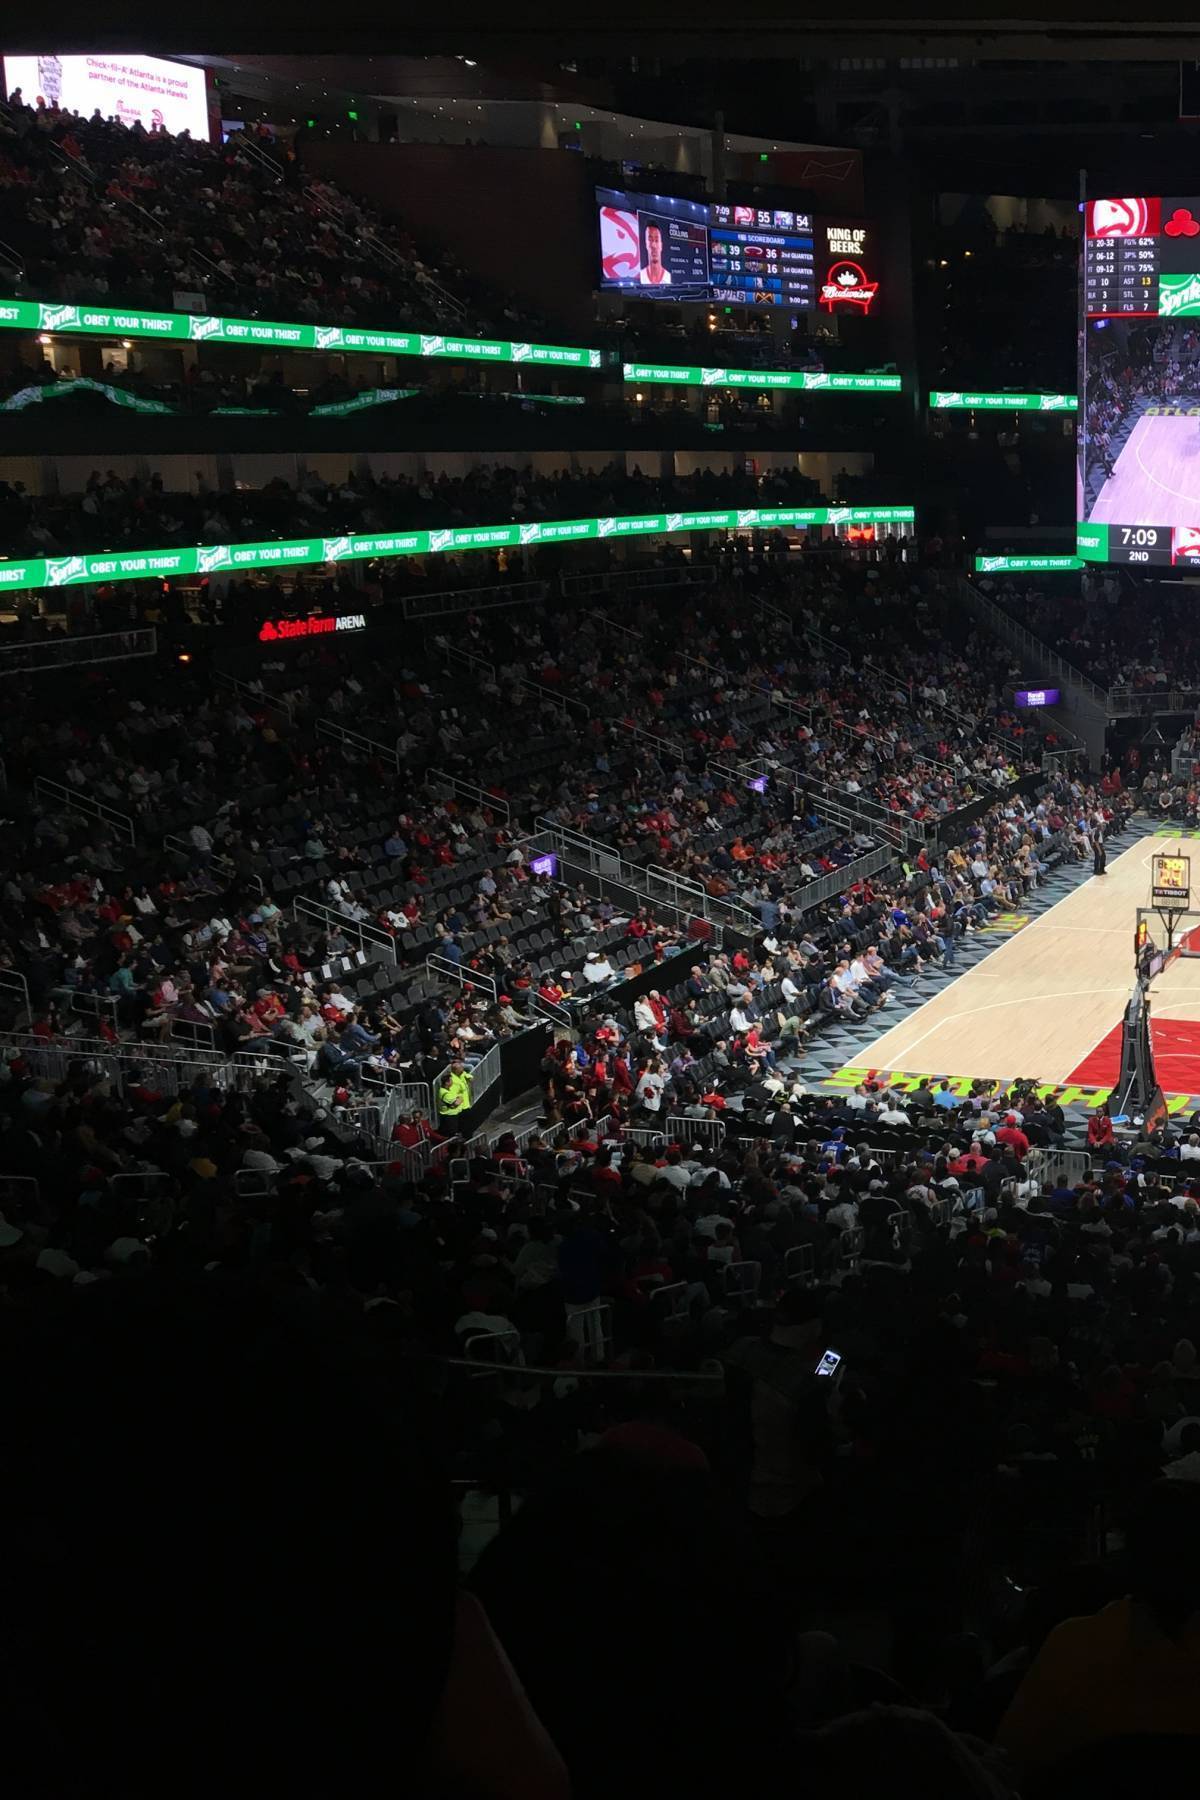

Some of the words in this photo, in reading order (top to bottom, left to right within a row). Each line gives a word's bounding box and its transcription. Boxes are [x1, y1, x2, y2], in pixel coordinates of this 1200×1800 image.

[129, 67, 154, 81] Atlanta
[155, 73, 161, 83] is
[168, 77, 188, 88] proud
[88, 71, 116, 85] partner
[118, 76, 126, 86] of
[127, 78, 139, 88] the
[140, 82, 165, 95] Atlanta
[166, 86, 188, 100] Hawks
[715, 205, 730, 216] 7:09
[757, 211, 770, 223] 55
[796, 215, 808, 227] 54
[669, 229, 688, 239] COLLINS
[748, 235, 785, 245] SCOREBOARD
[827, 227, 851, 241] KING
[853, 229, 866, 241] OF
[829, 240, 863, 254] BEERS.
[1096, 239, 1114, 247] 20-32
[1138, 238, 1154, 246] 62%
[729, 245, 740, 256] 39
[765, 248, 777, 258] 36
[790, 252, 813, 260] QUARTER
[1096, 252, 1114, 260] 06-12
[1138, 251, 1154, 259] 50%
[730, 261, 741, 270] 15
[767, 264, 777, 273] 16
[791, 267, 813, 275] QUARTER
[1096, 265, 1114, 273] 09-12
[1138, 264, 1154, 272] 75%
[1101, 278, 1109, 286] 10
[1142, 277, 1151, 285] 13
[822, 285, 874, 298] Budweiser
[43, 305, 76, 330] Sprite
[84, 314, 110, 326] OBEY
[113, 316, 139, 328] YOUR
[140, 318, 173, 331] THIRST
[1121, 528, 1157, 546] 7:09
[1129, 551, 1149, 561] 2ND
[50, 556, 83, 585] Sprite
[90, 561, 117, 574] OBEY
[120, 559, 147, 571] YOUR
[149, 556, 180, 569] THIRST
[277, 619, 308, 638] State
[308, 616, 335, 634] Farm
[335, 615, 366, 630] ARENA
[1163, 889, 1187, 897] TISSOT
